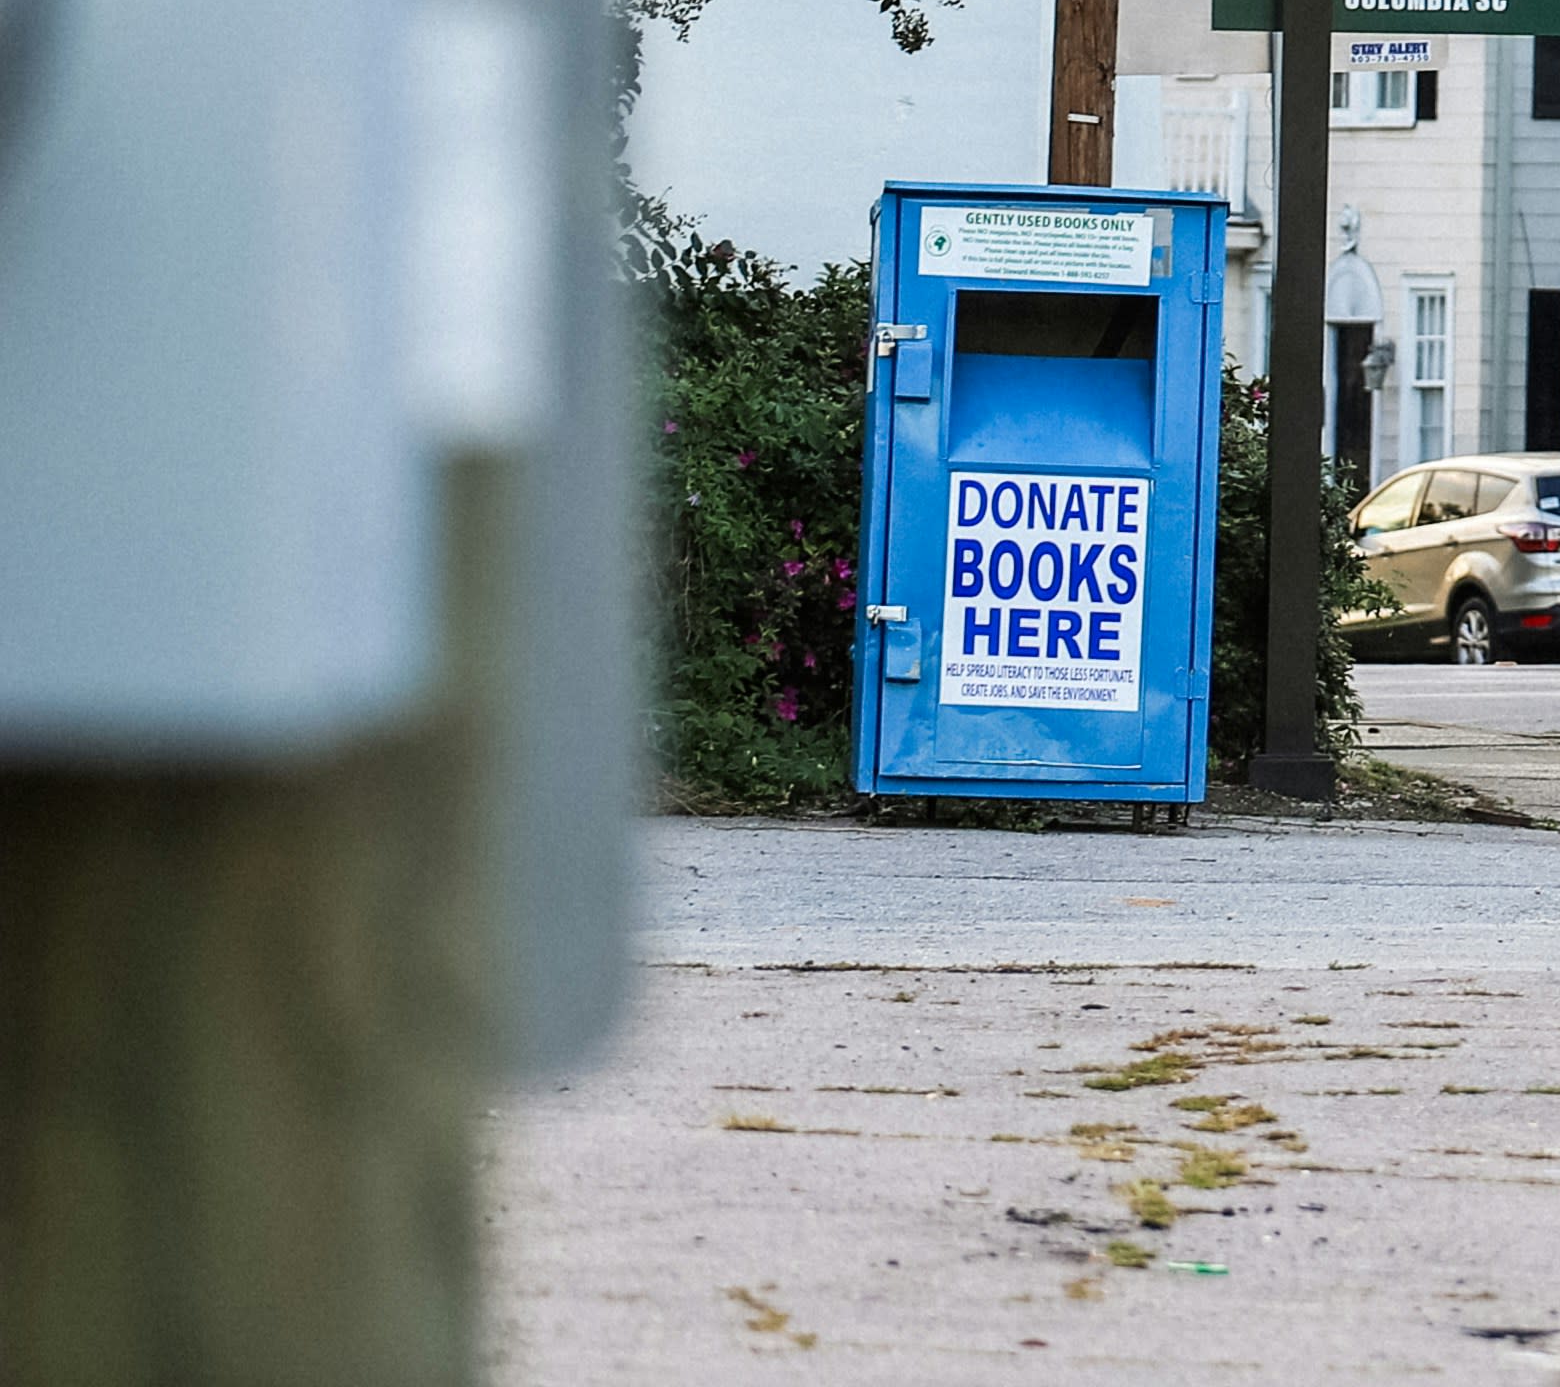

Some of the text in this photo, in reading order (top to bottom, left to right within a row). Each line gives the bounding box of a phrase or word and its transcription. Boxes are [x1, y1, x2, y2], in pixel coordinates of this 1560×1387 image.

[1351, 42, 1428, 55] STAY ALERT
[965, 212, 1135, 232] GENTLY USED BOOKS ONLY
[957, 479, 1140, 534] DONATE
[951, 538, 1138, 605] BOOKS
[962, 606, 1122, 661] HERE
[945, 662, 965, 677] HELP
[966, 663, 996, 678] SPREAD
[997, 664, 1032, 679] LITERACY
[1033, 665, 1044, 680] TO
[1044, 666, 1069, 681] THOSE
[1070, 667, 1088, 682] LESS
[961, 683, 988, 698] CREATE
[1011, 685, 1027, 699] AND
[1028, 685, 1047, 700] SAVE
[1047, 686, 1062, 700] THE
